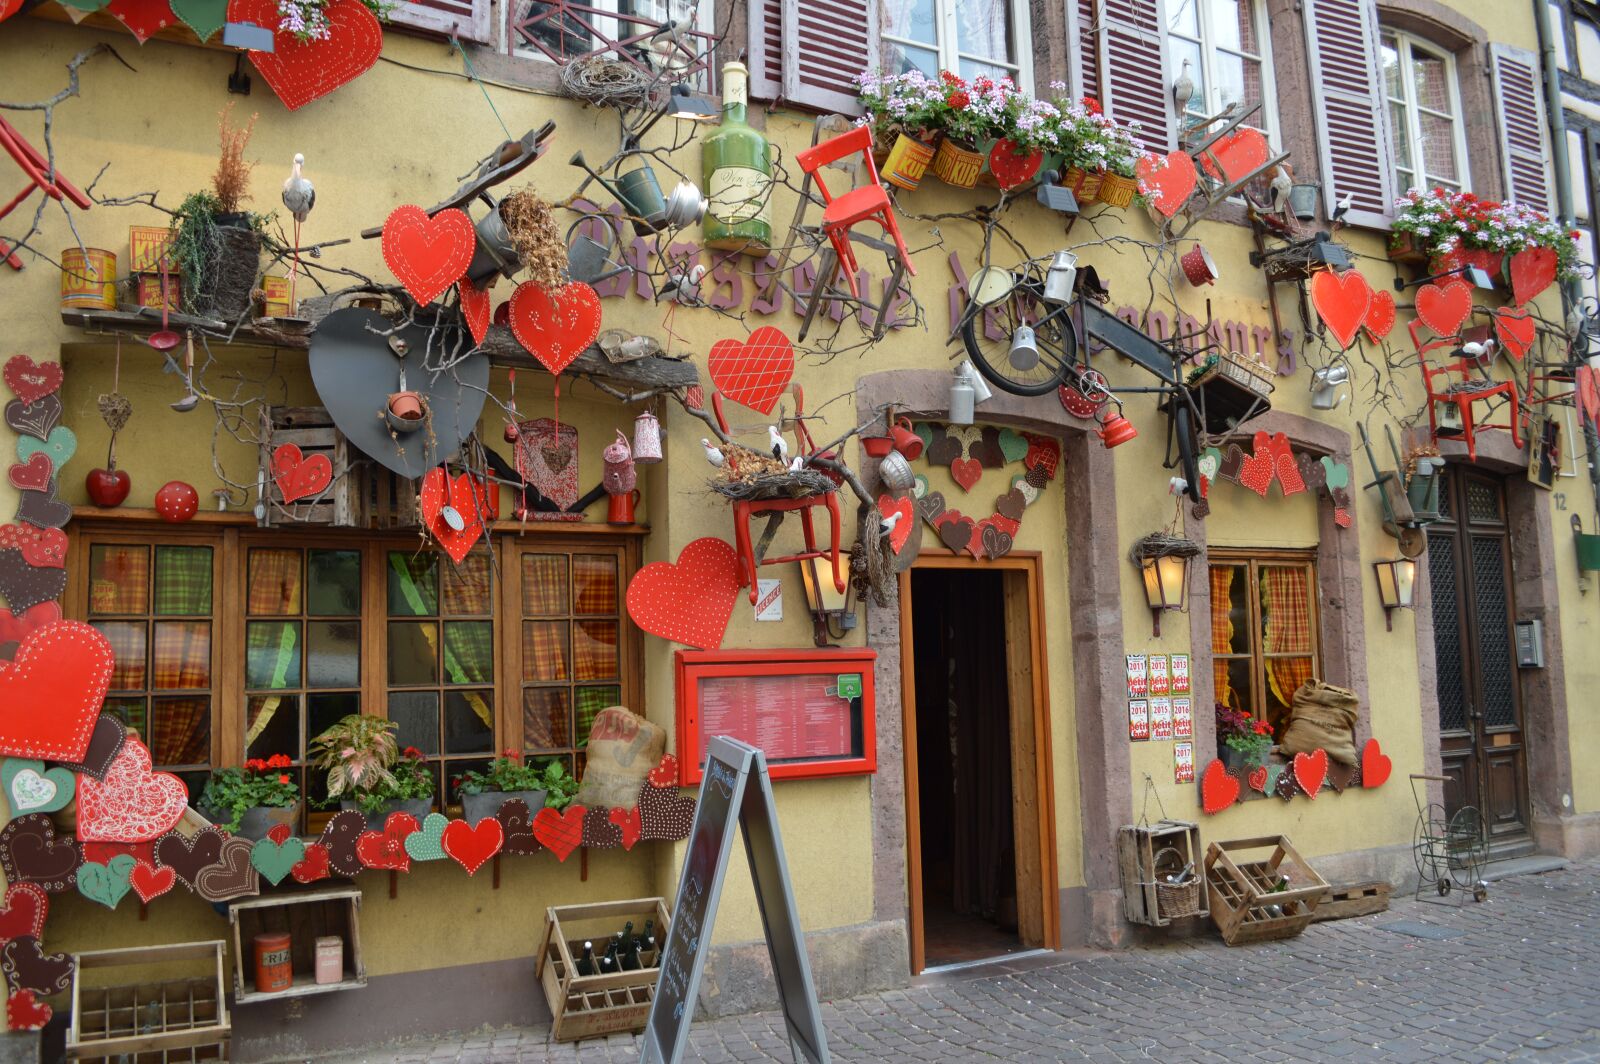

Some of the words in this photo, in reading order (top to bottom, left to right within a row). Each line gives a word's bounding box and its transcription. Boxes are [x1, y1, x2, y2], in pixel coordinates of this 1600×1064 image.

[900, 157, 927, 180] KUB
[934, 149, 953, 179] KUB
[949, 160, 979, 187] KUB
[1110, 187, 1133, 207] KUB
[135, 240, 176, 270] KUB
[63, 268, 99, 291] KUB
[1553, 493, 1568, 511] 12
[756, 586, 781, 615] LICENCE
[1129, 662, 1144, 670] 2011
[1151, 661, 1166, 670] 2012
[1173, 661, 1187, 669] 2013
[1131, 706, 1147, 715] 2014
[1153, 705, 1168, 714] 2015
[1174, 705, 1190, 714] 2016
[1176, 748, 1190, 757] 2017
[268, 950, 289, 964] RIZ
